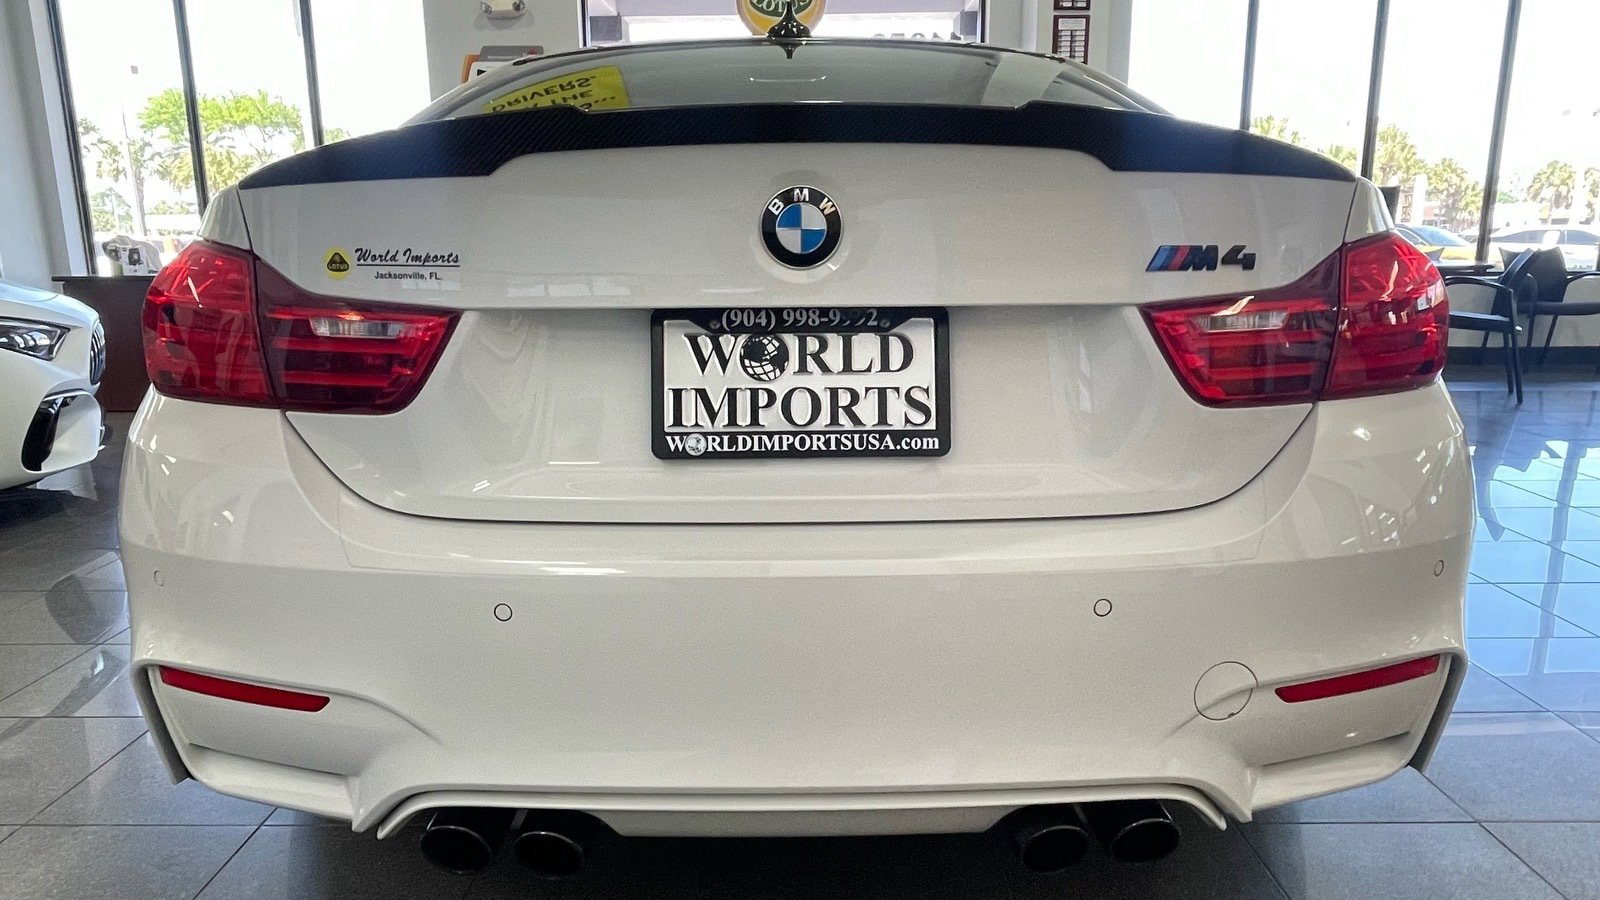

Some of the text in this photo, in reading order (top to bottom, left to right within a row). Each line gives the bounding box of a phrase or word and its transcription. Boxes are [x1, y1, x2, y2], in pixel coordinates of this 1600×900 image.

[767, 188, 836, 216] BMW
[354, 248, 460, 265] World Imports
[374, 271, 427, 281] Jacksonville,
[721, 308, 878, 330] (904) 998-92
[667, 385, 933, 428] IMPORTS
